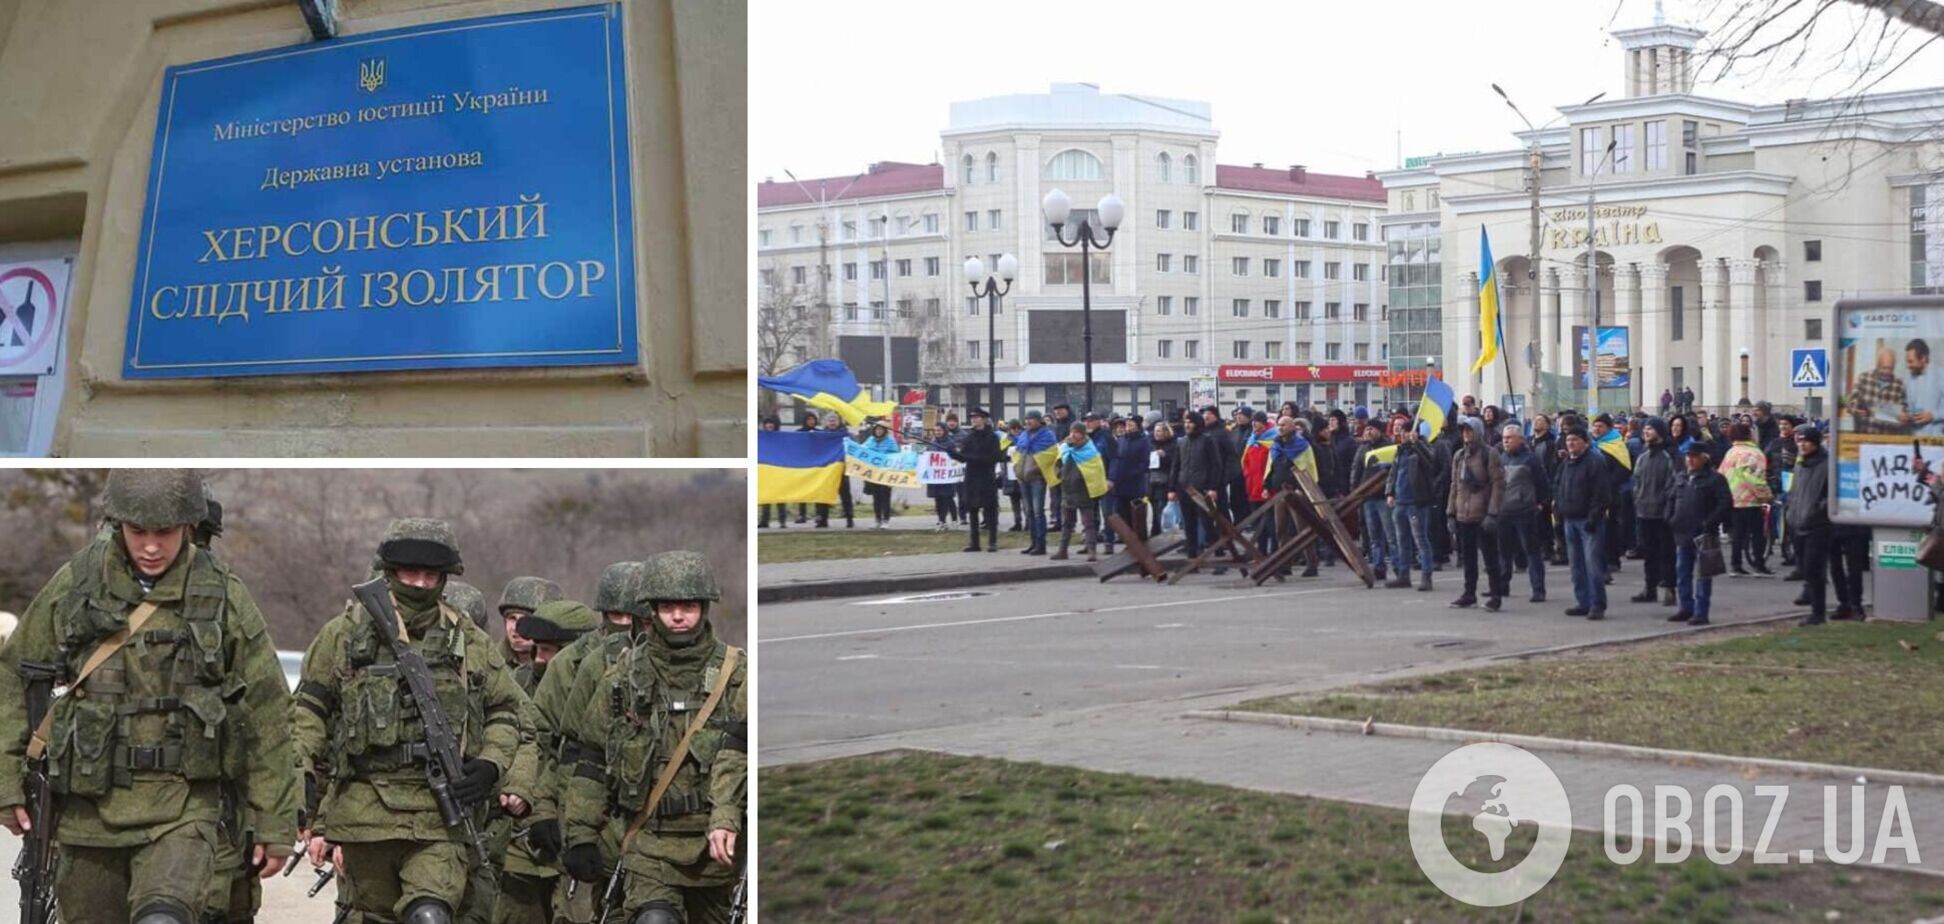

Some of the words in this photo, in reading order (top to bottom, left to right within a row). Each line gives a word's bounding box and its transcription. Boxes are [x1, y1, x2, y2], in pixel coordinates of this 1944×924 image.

[213, 110, 351, 142] Міністерство
[358, 94, 446, 122] юстиції
[453, 86, 548, 113] України
[260, 161, 369, 191] Державна
[376, 150, 483, 180] установа
[198, 192, 549, 263] ХЕРСОНСЬКИЙ
[151, 265, 348, 325] СЛІДЧИЙ
[358, 260, 606, 309] ІЗОЛЯТОР
